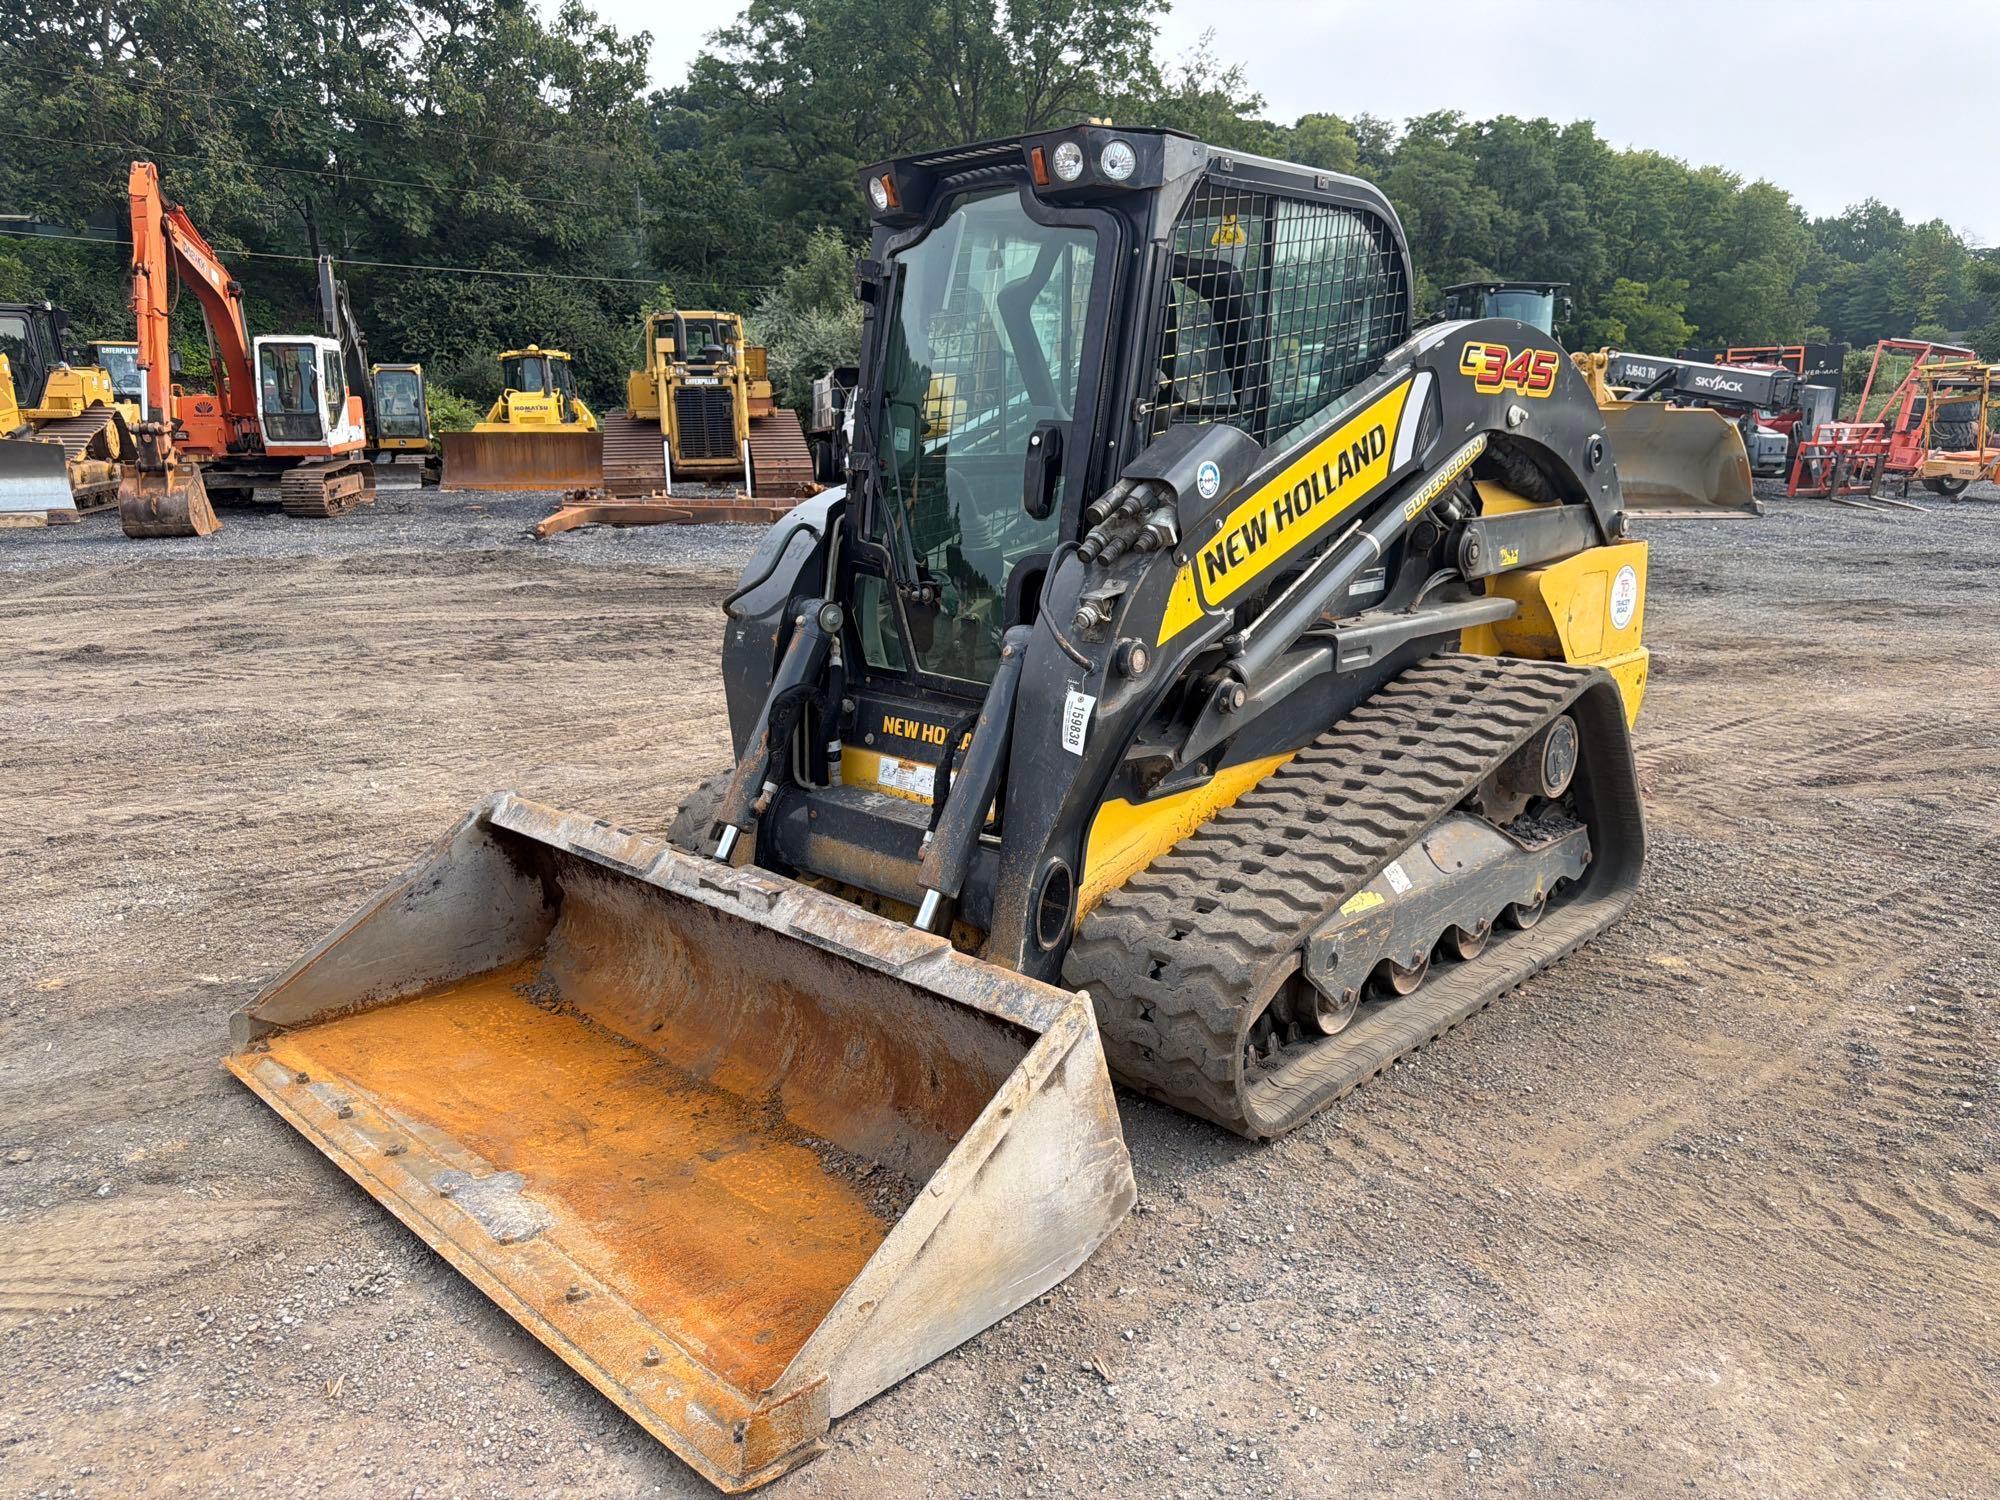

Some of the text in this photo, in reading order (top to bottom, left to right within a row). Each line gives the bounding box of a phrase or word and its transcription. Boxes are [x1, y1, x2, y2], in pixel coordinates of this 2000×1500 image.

[1460, 342, 1558, 397] C345
[1625, 364, 1657, 379] SJ643 TH
[1695, 375, 1743, 392] SKYJACK
[1203, 424, 1386, 585] NEW HOLLAND
[883, 715, 920, 739] NEW
[1068, 706, 1085, 746] 159838
